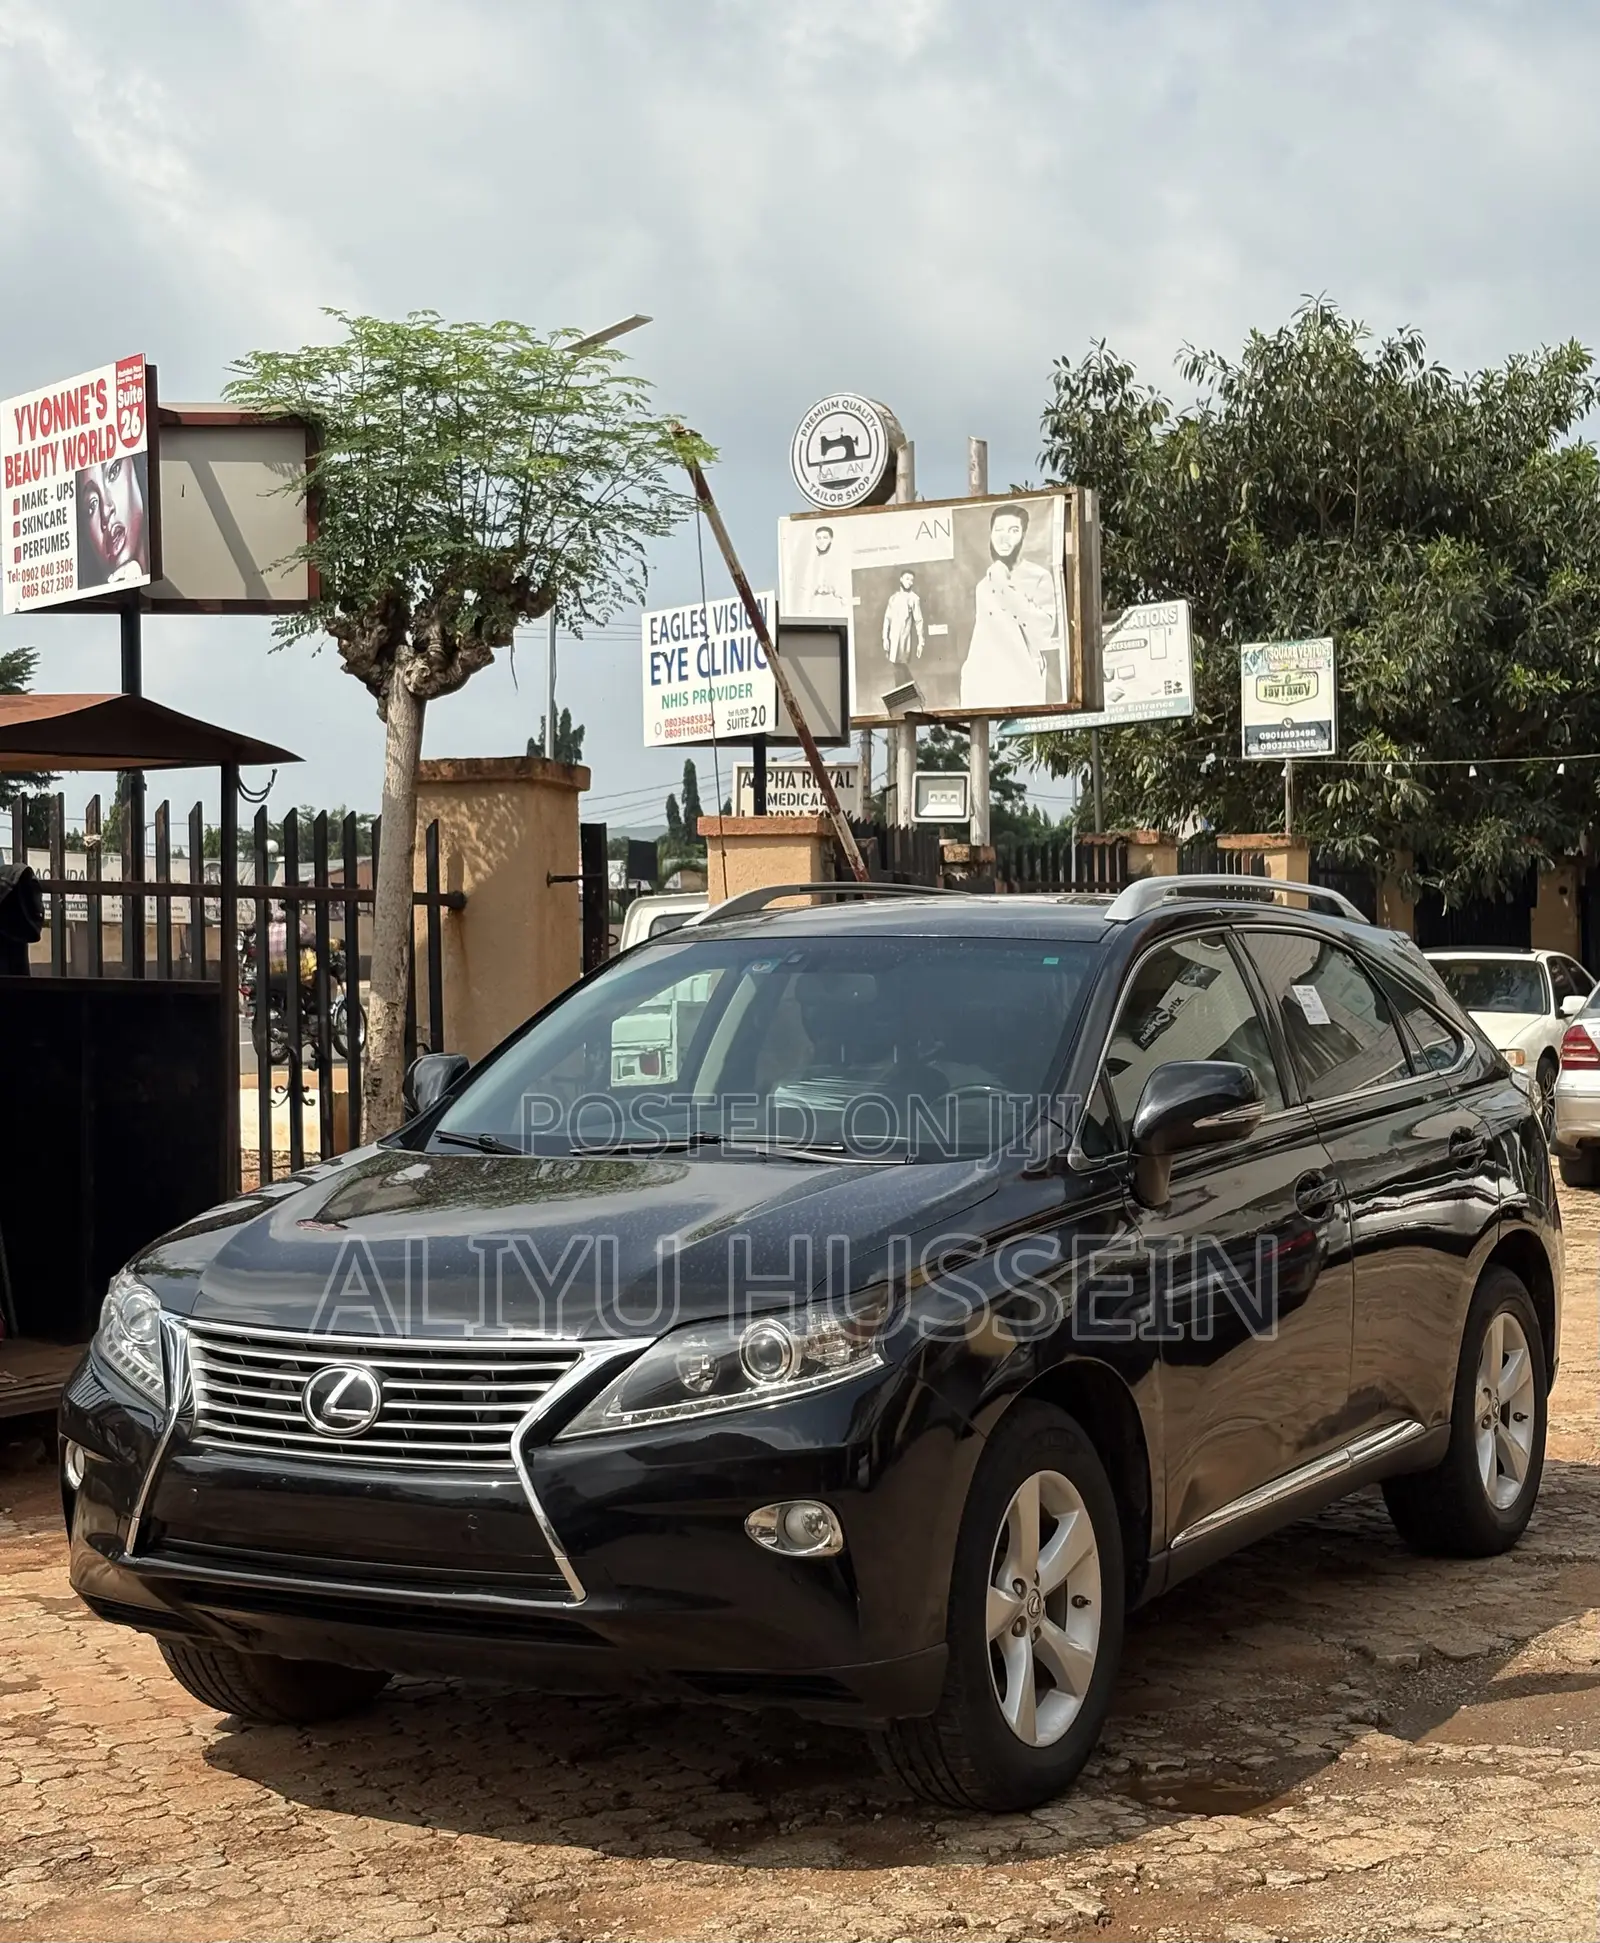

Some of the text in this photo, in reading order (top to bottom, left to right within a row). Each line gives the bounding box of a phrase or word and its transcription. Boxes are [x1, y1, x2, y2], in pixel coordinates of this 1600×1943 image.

[14, 378, 108, 445] YVONNE'S
[117, 384, 143, 410] Suite
[120, 407, 142, 441] 26
[800, 399, 879, 437] PREMIUM QUALITY
[4, 424, 117, 490] BEAUTY WORLD
[21, 487, 48, 512] MAKE
[56, 480, 75, 502] UPS
[808, 475, 871, 503] TAILOR SHOP
[21, 506, 68, 536] SKINCARE
[22, 531, 70, 561] PERFUMES
[22, 566, 39, 583] 0902
[40, 562, 54, 578] 040
[56, 557, 73, 575] 3506
[56, 575, 73, 591] 2309
[650, 607, 708, 646] EAGLES
[650, 647, 689, 687] EYE
[661, 682, 753, 710] NHIS PROVIDER
[727, 704, 767, 731] SUITE 20
[742, 770, 797, 789] APHA
[767, 792, 828, 807] MEDICAL
